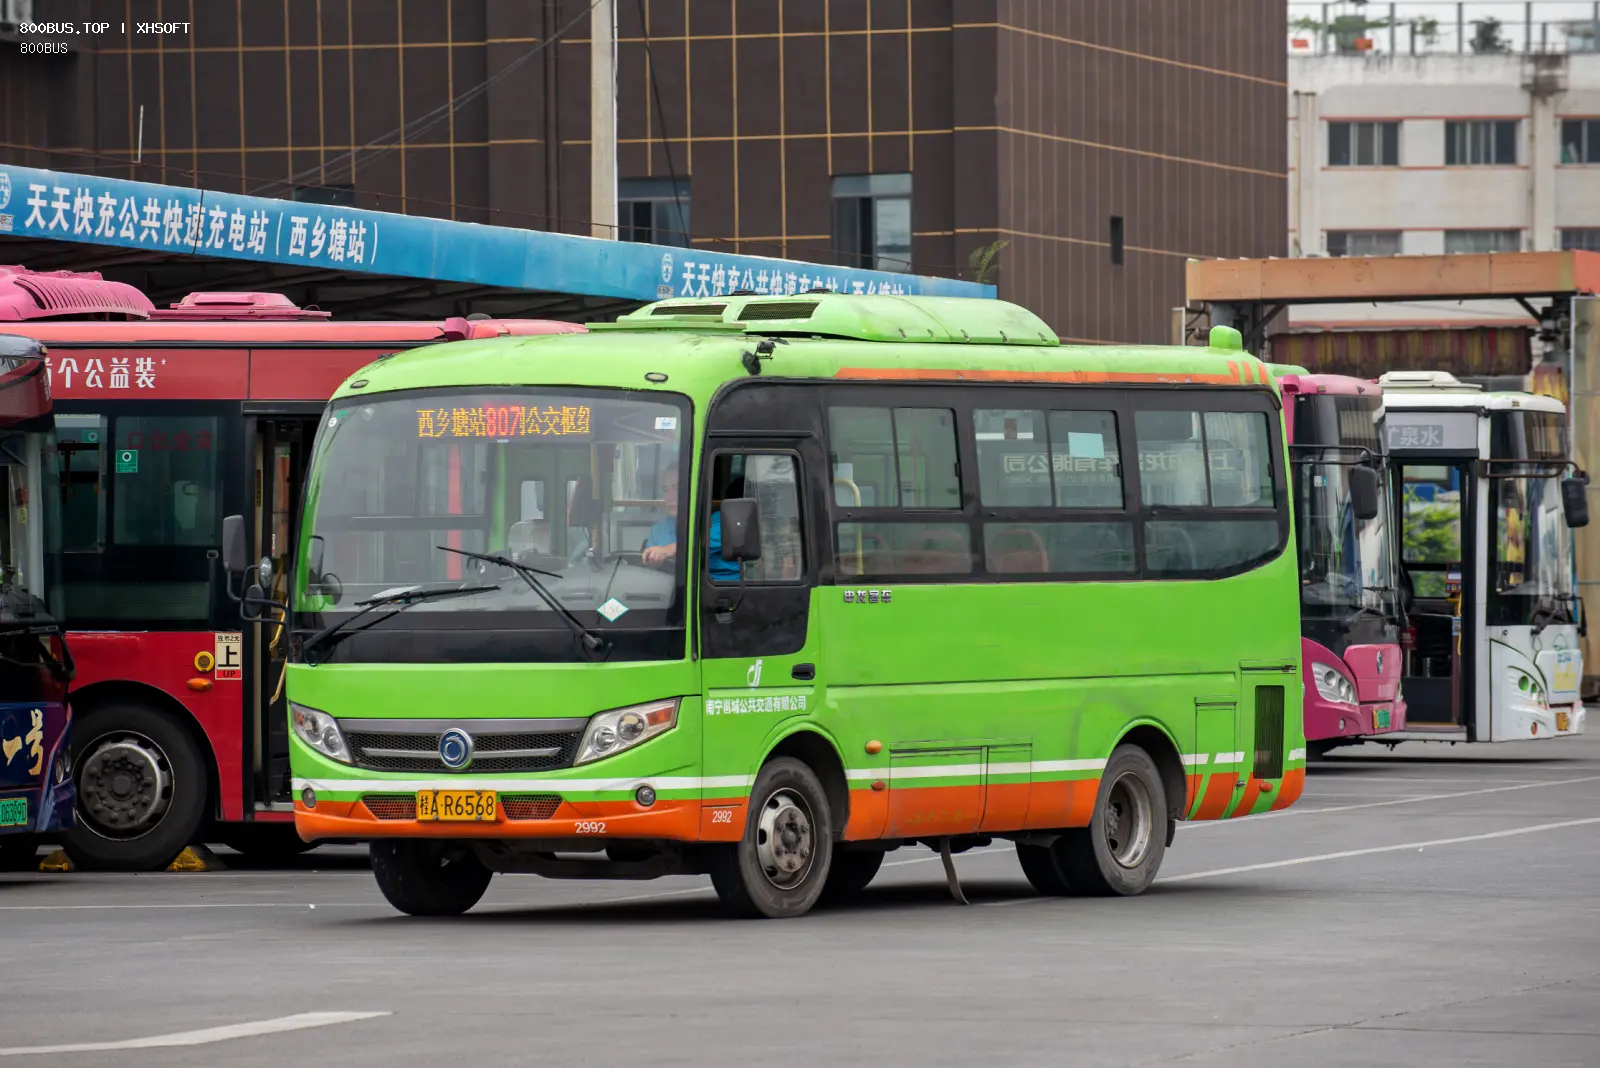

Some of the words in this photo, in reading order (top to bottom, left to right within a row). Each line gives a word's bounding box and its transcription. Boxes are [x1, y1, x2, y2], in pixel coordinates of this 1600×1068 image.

[217, 645, 240, 667] 上
[712, 810, 732, 823] 2992
[574, 821, 606, 834] 2992
